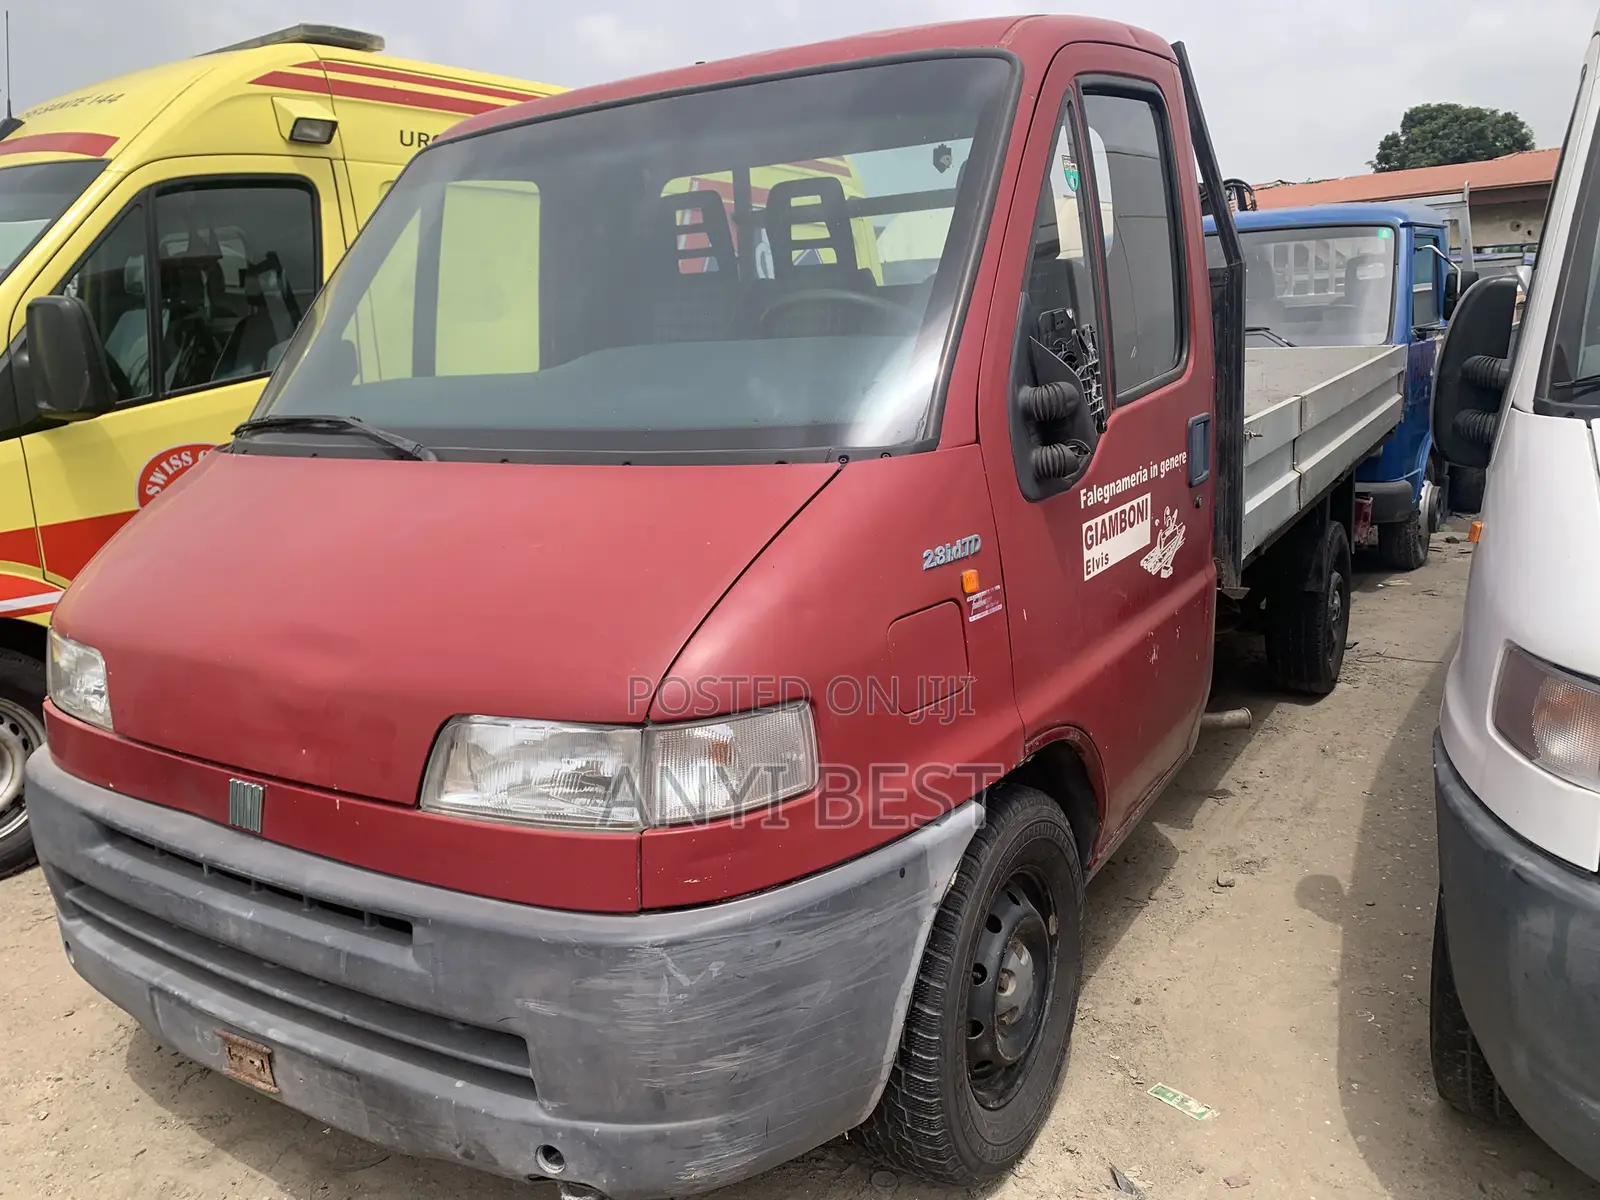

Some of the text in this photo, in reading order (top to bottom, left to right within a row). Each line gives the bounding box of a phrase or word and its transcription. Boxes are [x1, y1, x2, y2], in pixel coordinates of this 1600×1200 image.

[87, 92, 125, 106] 144
[400, 130, 440, 148] UR
[145, 450, 193, 497] SWISS
[1079, 451, 1187, 509] Falegnameria in genere
[1084, 497, 1149, 551] GIAMBONI
[1085, 552, 1110, 576] Elvis
